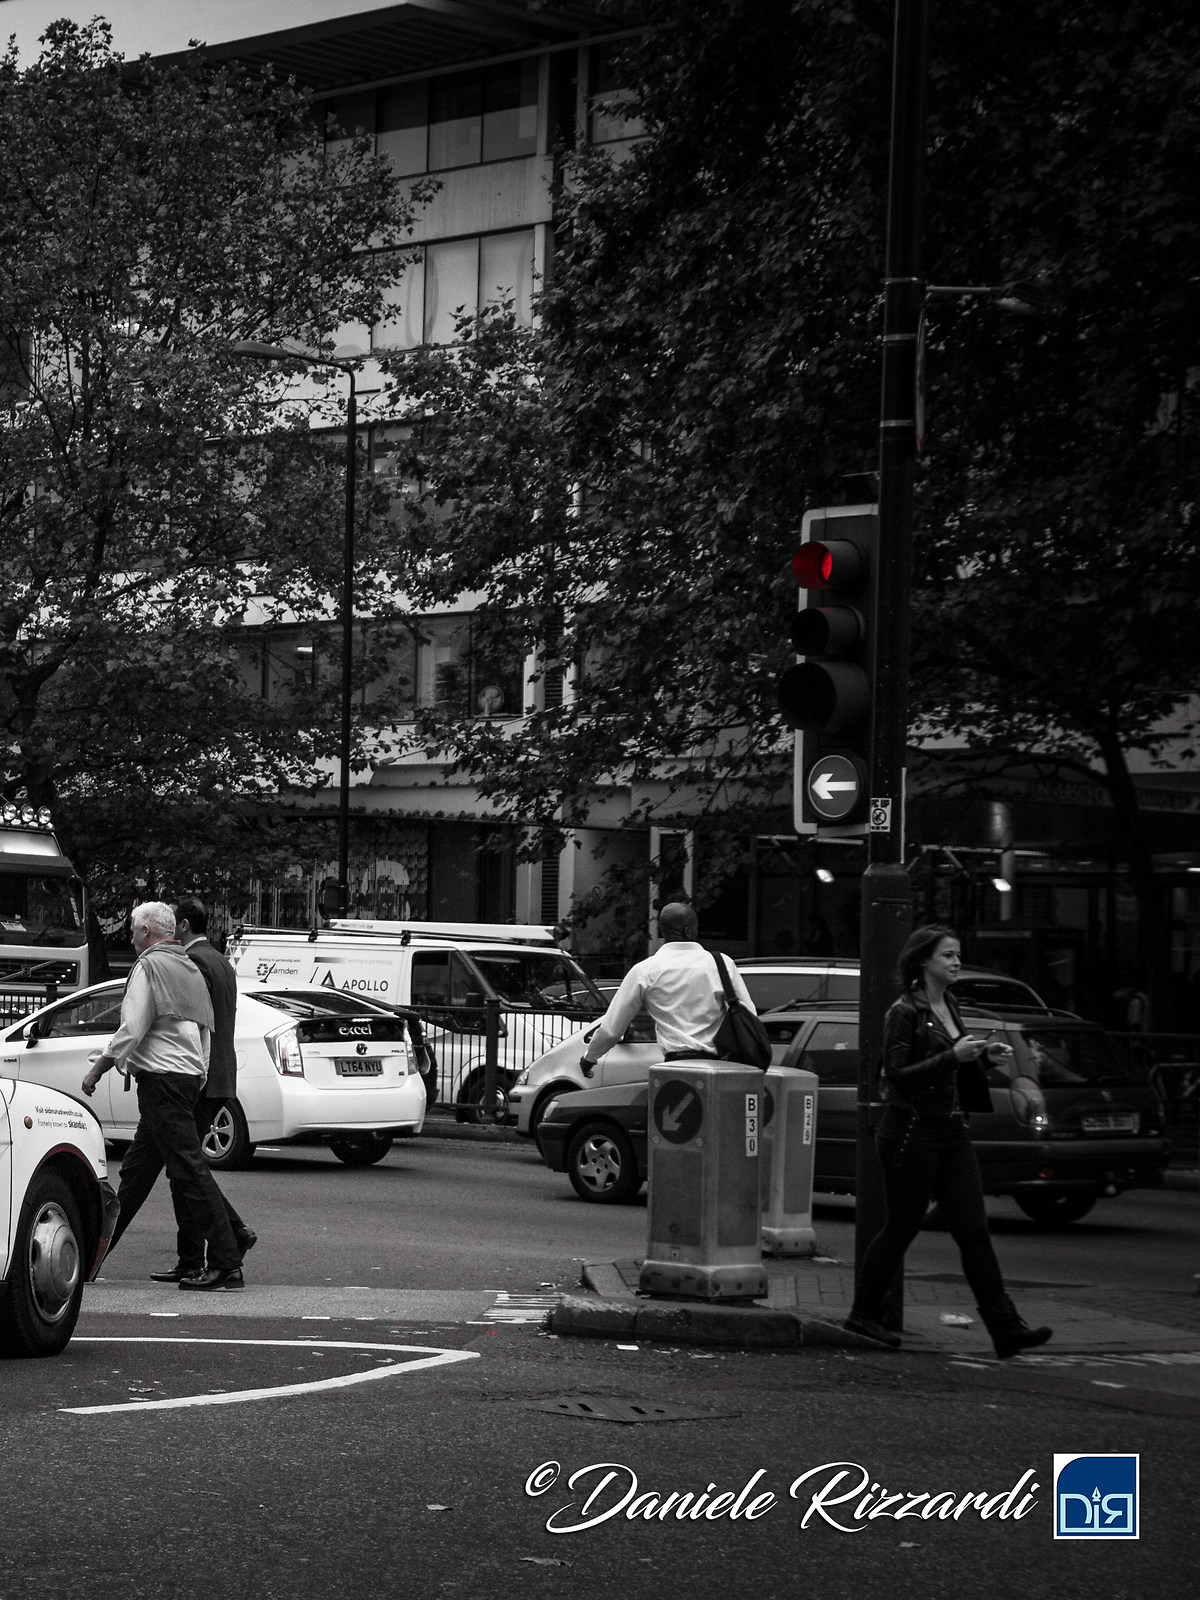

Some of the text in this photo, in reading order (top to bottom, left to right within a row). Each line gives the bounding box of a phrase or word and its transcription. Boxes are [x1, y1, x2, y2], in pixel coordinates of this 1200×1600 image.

[342, 979, 389, 992] APOLLO
[339, 1024, 373, 1036] excel
[340, 1060, 382, 1073] LT64 NYU
